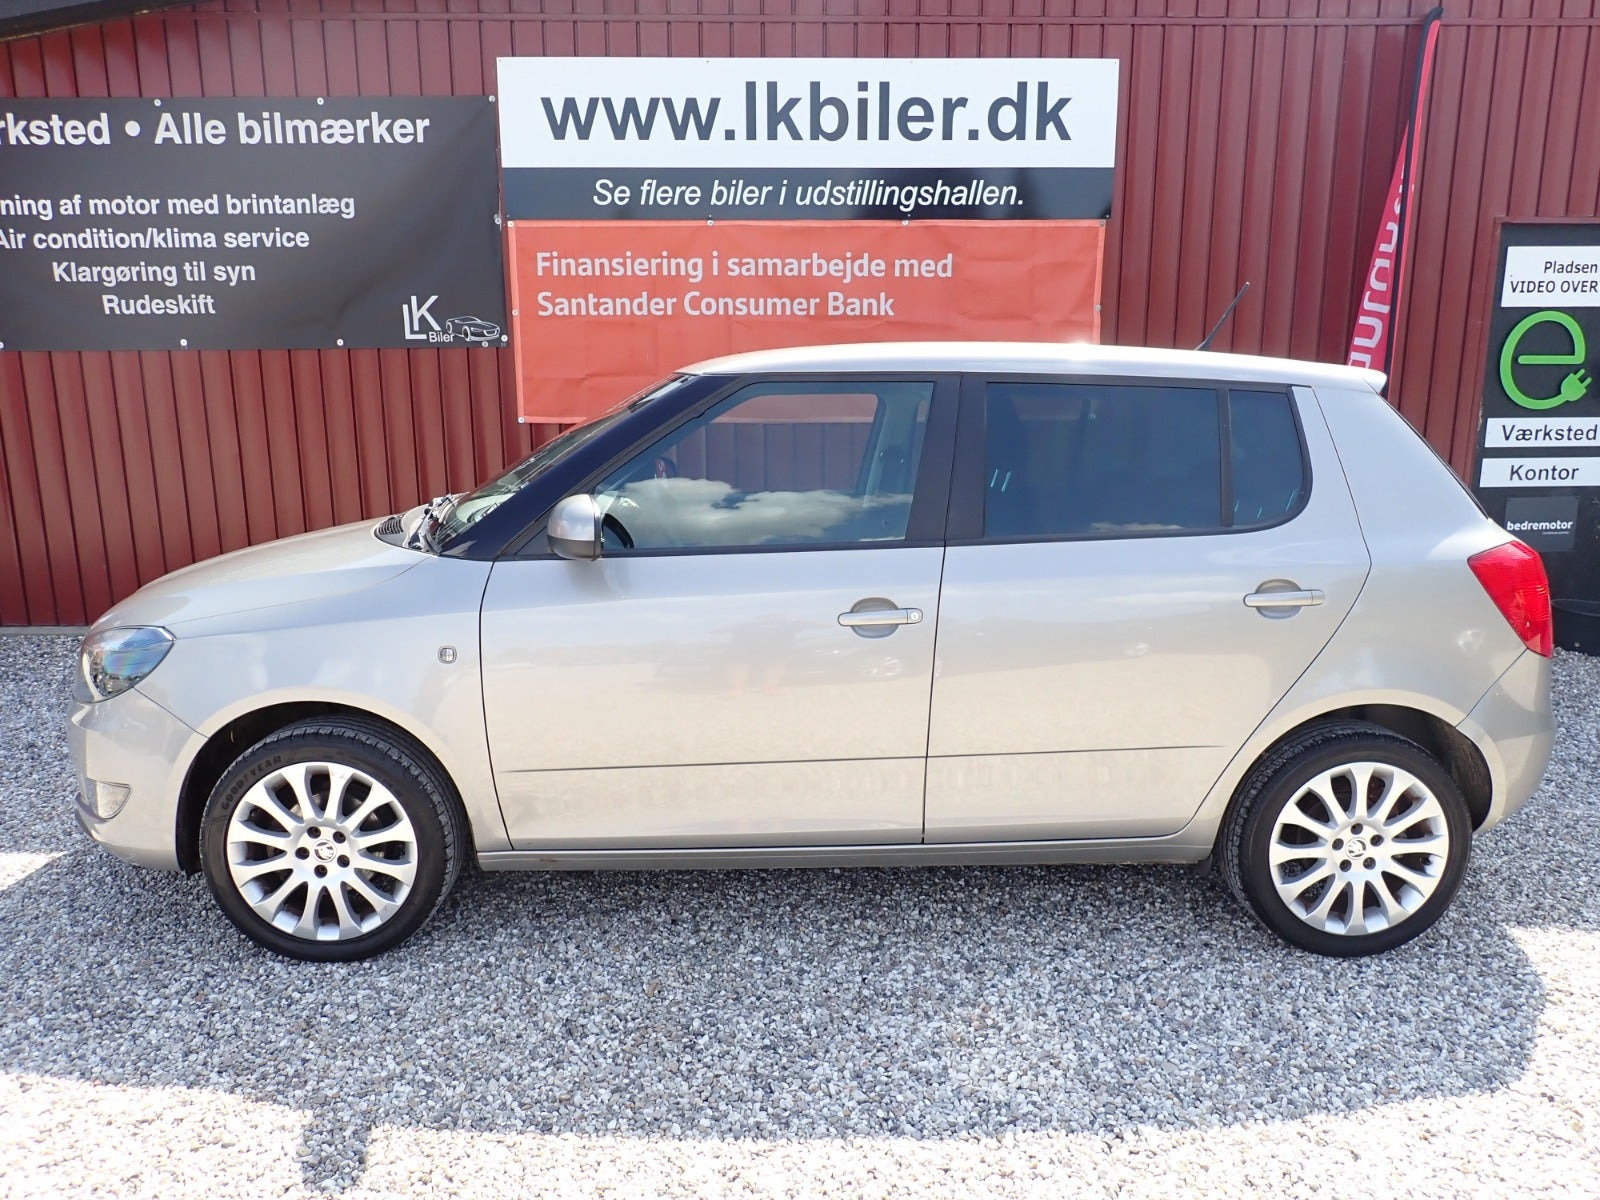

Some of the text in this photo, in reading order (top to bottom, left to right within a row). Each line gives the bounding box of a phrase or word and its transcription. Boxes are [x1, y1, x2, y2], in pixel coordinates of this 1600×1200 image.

[540, 81, 1072, 142] www.lkbiler.dk
[154, 113, 227, 145] Alle
[237, 112, 431, 145] bilmærker
[60, 194, 82, 216] af
[89, 195, 160, 215] motor
[168, 193, 219, 215] med
[226, 193, 355, 219] brintanlæg
[593, 178, 1024, 211] Se flere biler i udstillingshallen.
[33, 227, 217, 249] condition/klima
[224, 227, 310, 249] service
[53, 261, 256, 287] Klargøring til syn
[536, 251, 953, 284] Finansiering i samarbejde med
[1544, 261, 1598, 274] Pladsen
[1510, 280, 1599, 293] VIDEO OVER
[102, 293, 216, 315] Rudeskift
[537, 291, 895, 317] Santander Consumer Bank
[402, 295, 441, 340] LK
[429, 331, 454, 343] Biler
[1502, 424, 1598, 441] Værksted
[1509, 464, 1580, 481] Kontor
[1506, 520, 1573, 531] bedremotor
